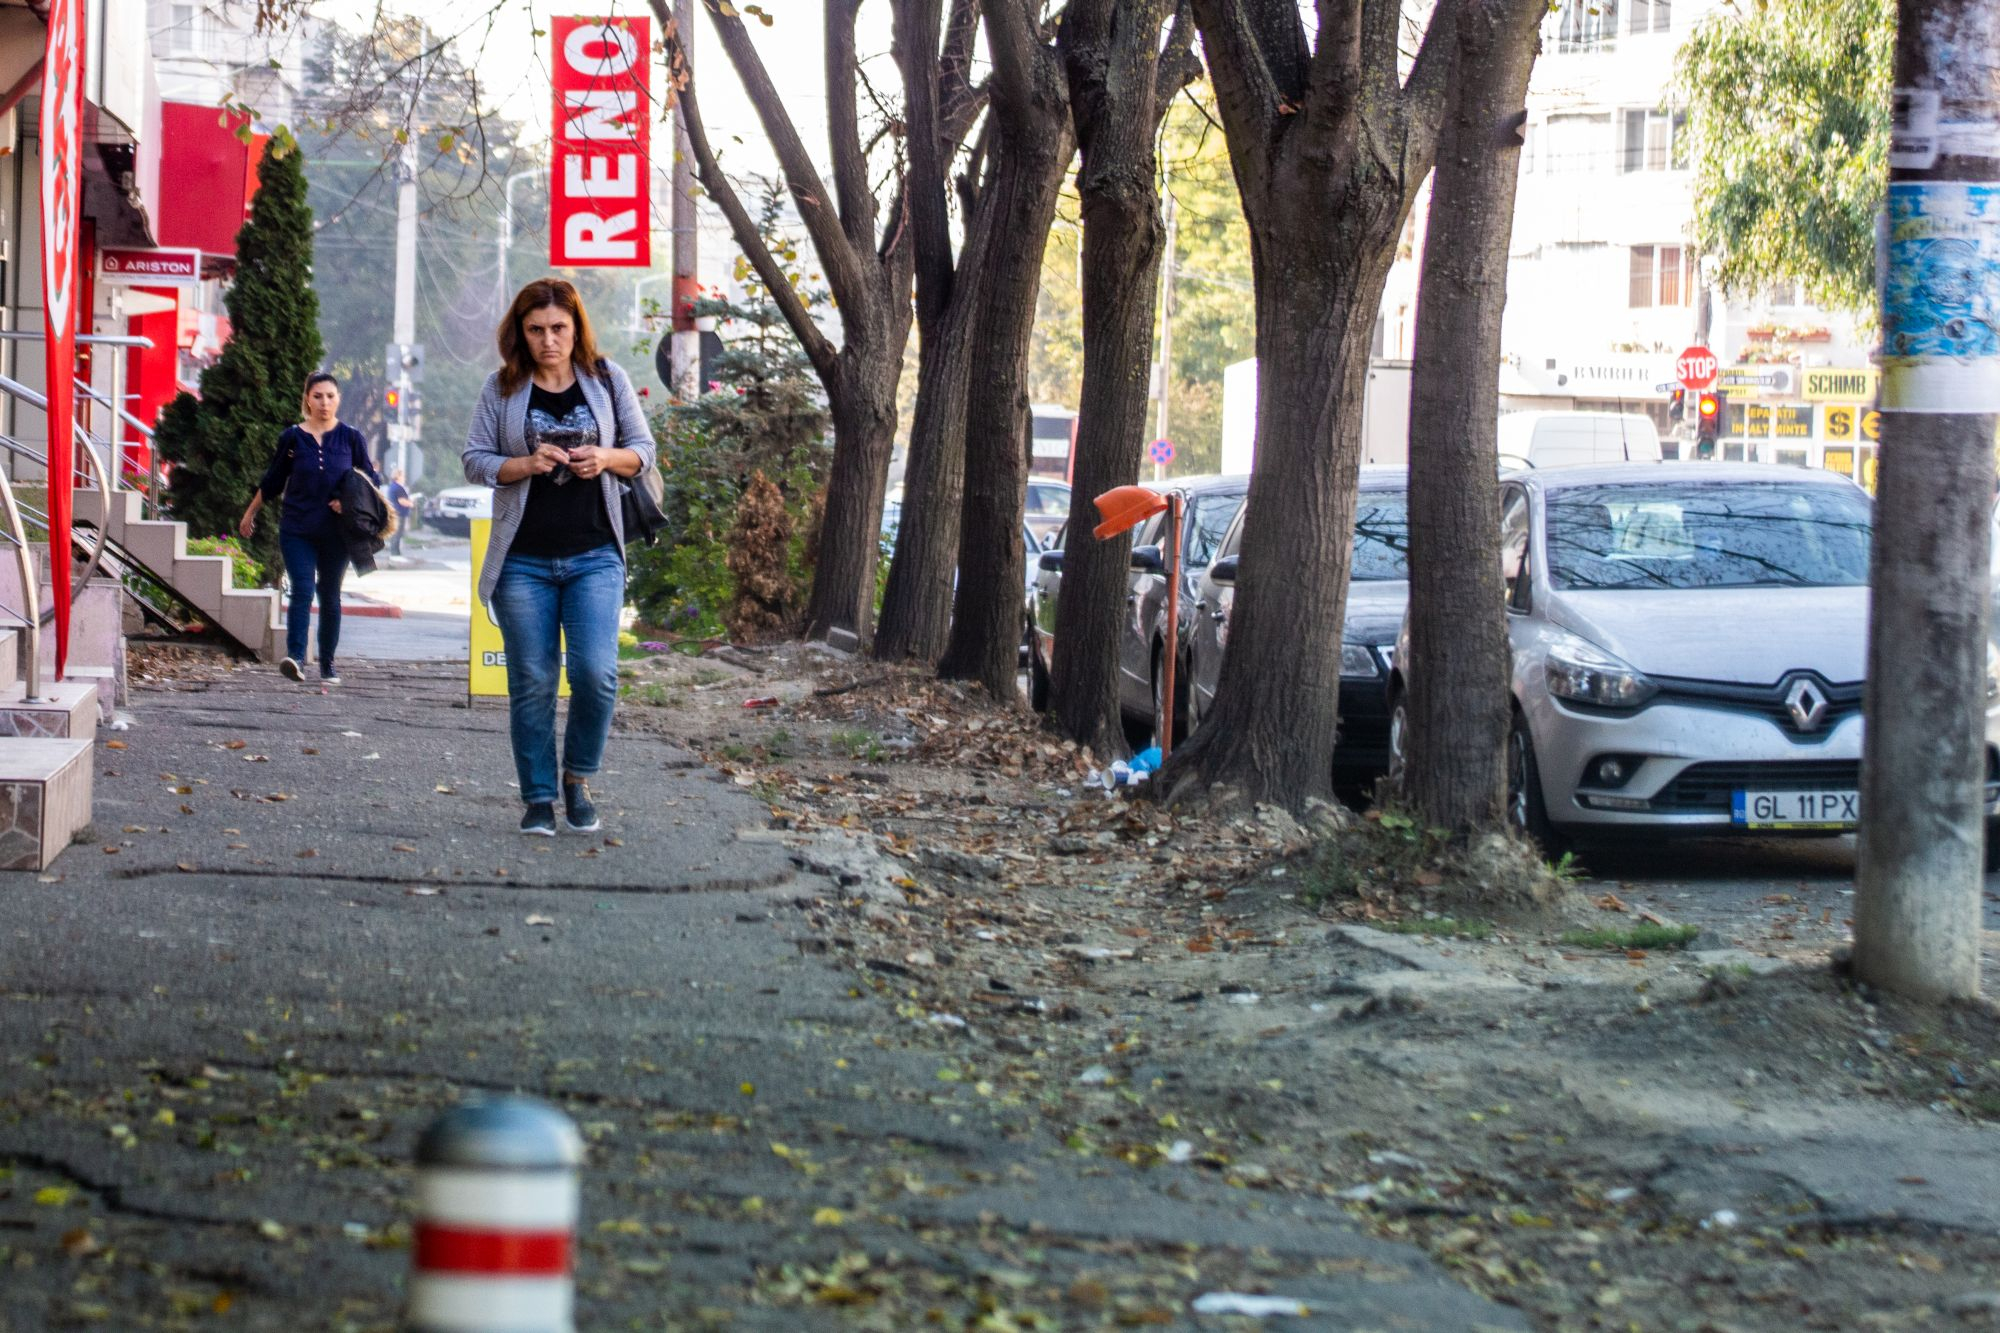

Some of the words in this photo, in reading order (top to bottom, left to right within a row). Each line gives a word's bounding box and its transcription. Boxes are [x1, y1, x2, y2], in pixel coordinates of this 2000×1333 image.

[564, 24, 637, 260] RENO
[125, 260, 191, 273] ARISTON
[1677, 357, 1716, 380] STOP
[1808, 374, 1867, 395] SCHIMB
[1731, 423, 1808, 436] INALTMINTE
[1754, 796, 1786, 819] GL
[1798, 795, 1814, 818] 11
